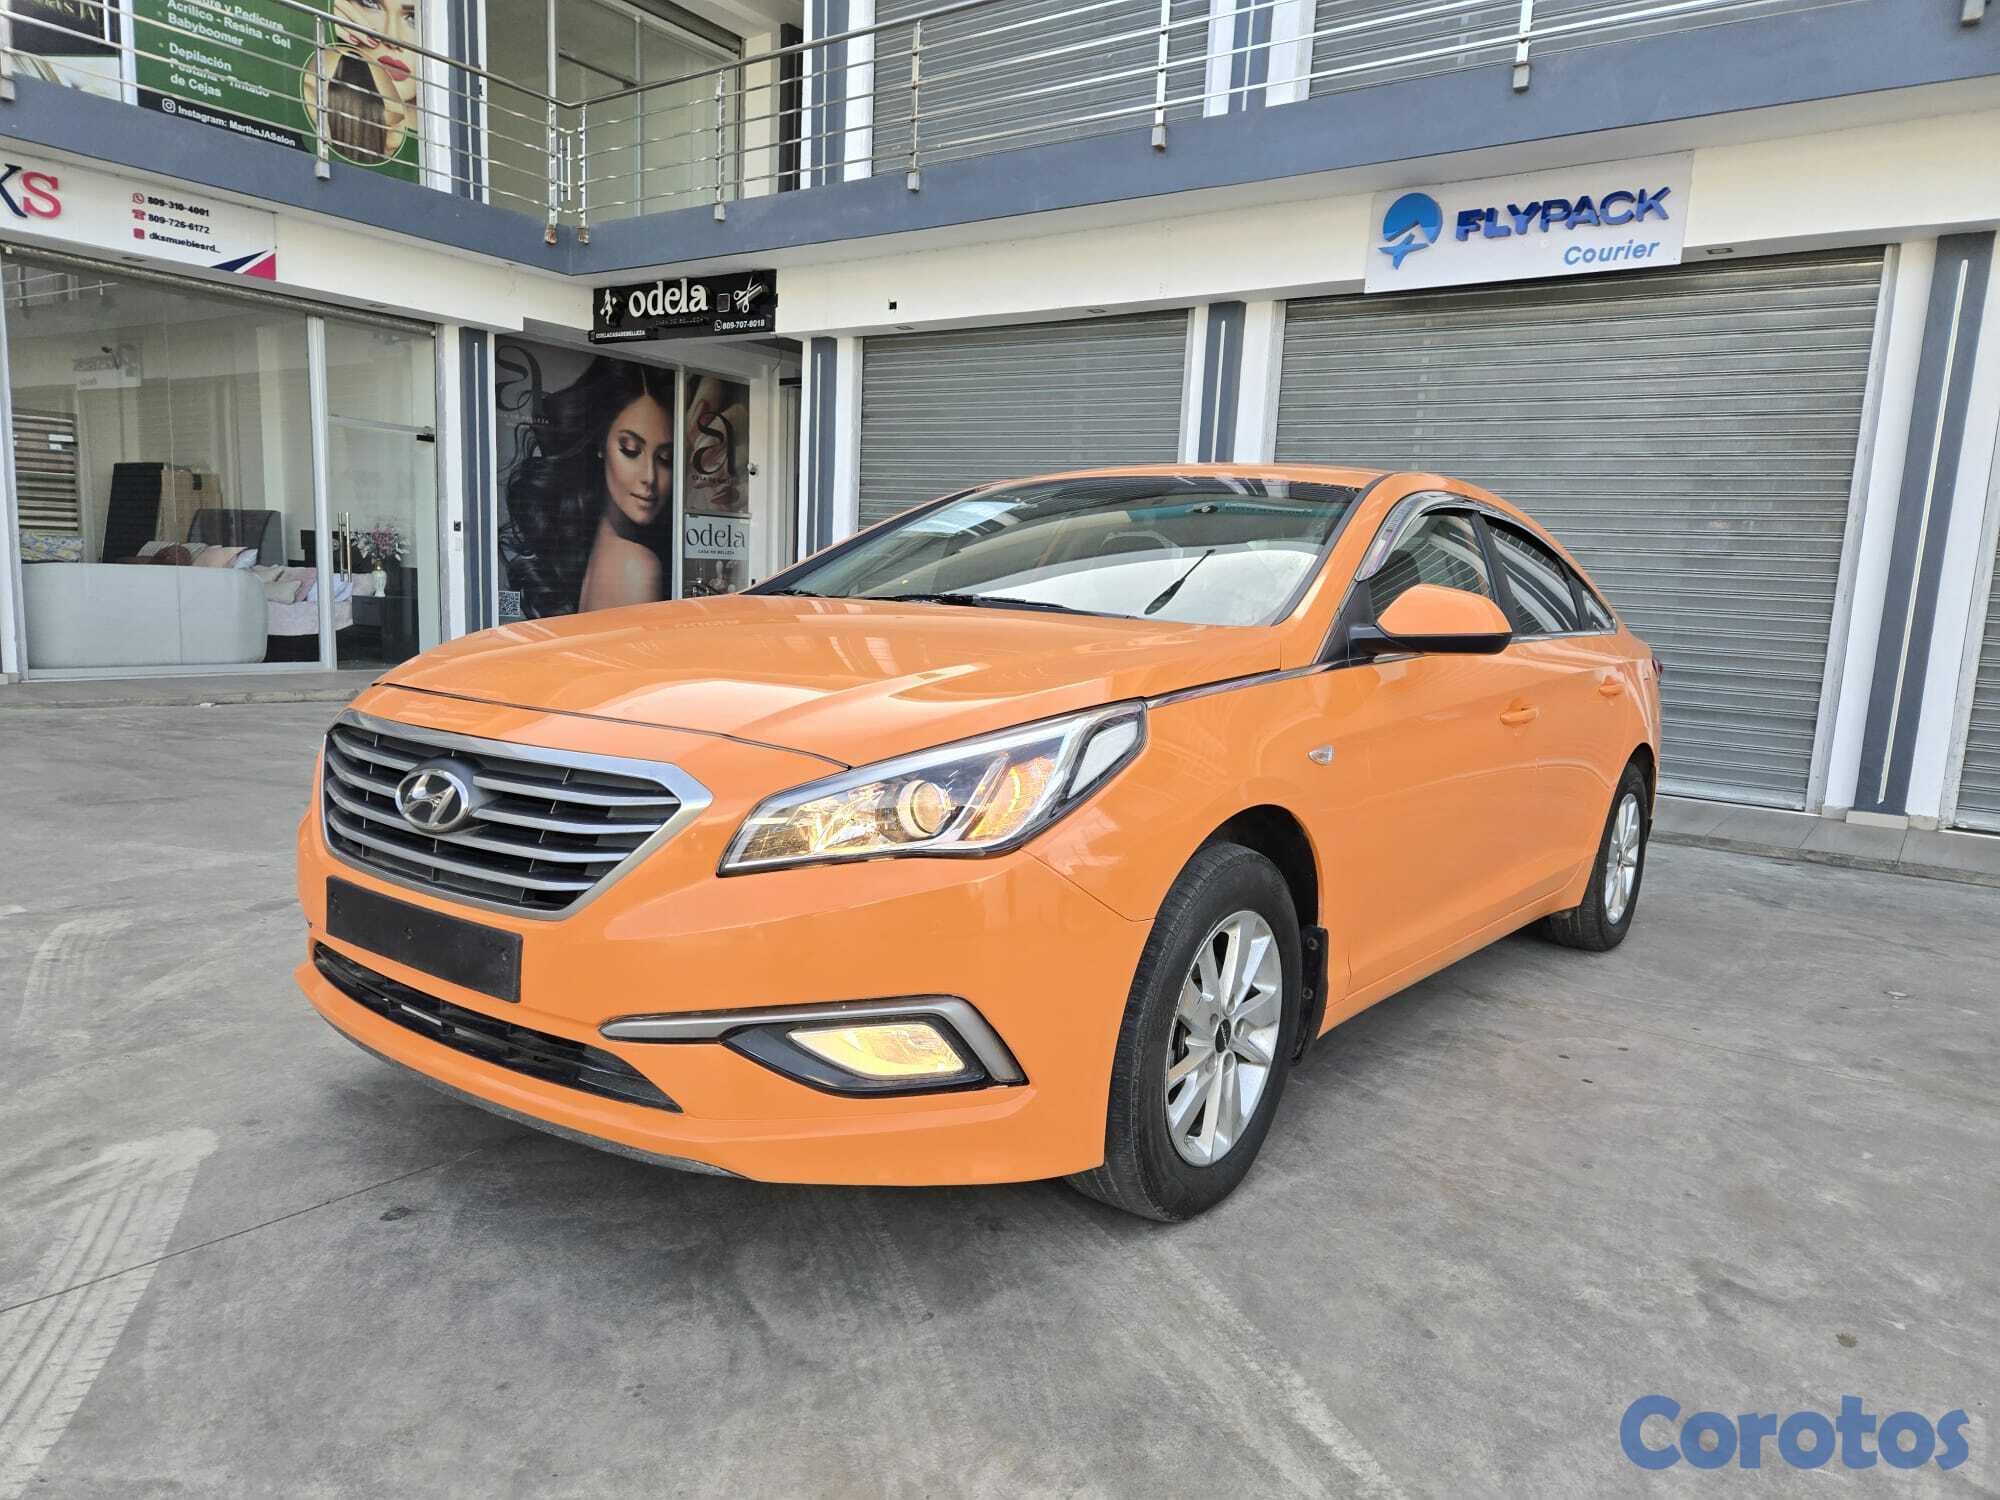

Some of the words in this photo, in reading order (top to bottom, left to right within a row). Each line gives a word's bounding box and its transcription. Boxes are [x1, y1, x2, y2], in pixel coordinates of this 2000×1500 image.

[167, 12, 244, 46] Babyboomer
[223, 16, 263, 39] Resina
[272, 34, 291, 49] Gel
[169, 43, 232, 71] Depilación
[170, 74, 185, 86] de
[188, 78, 222, 97] Cejas
[178, 105, 227, 126] Instagram:
[1455, 186, 1671, 241] FLYPACK
[1563, 239, 1661, 266] Courier
[628, 277, 709, 318] odela
[686, 523, 745, 548] odela
